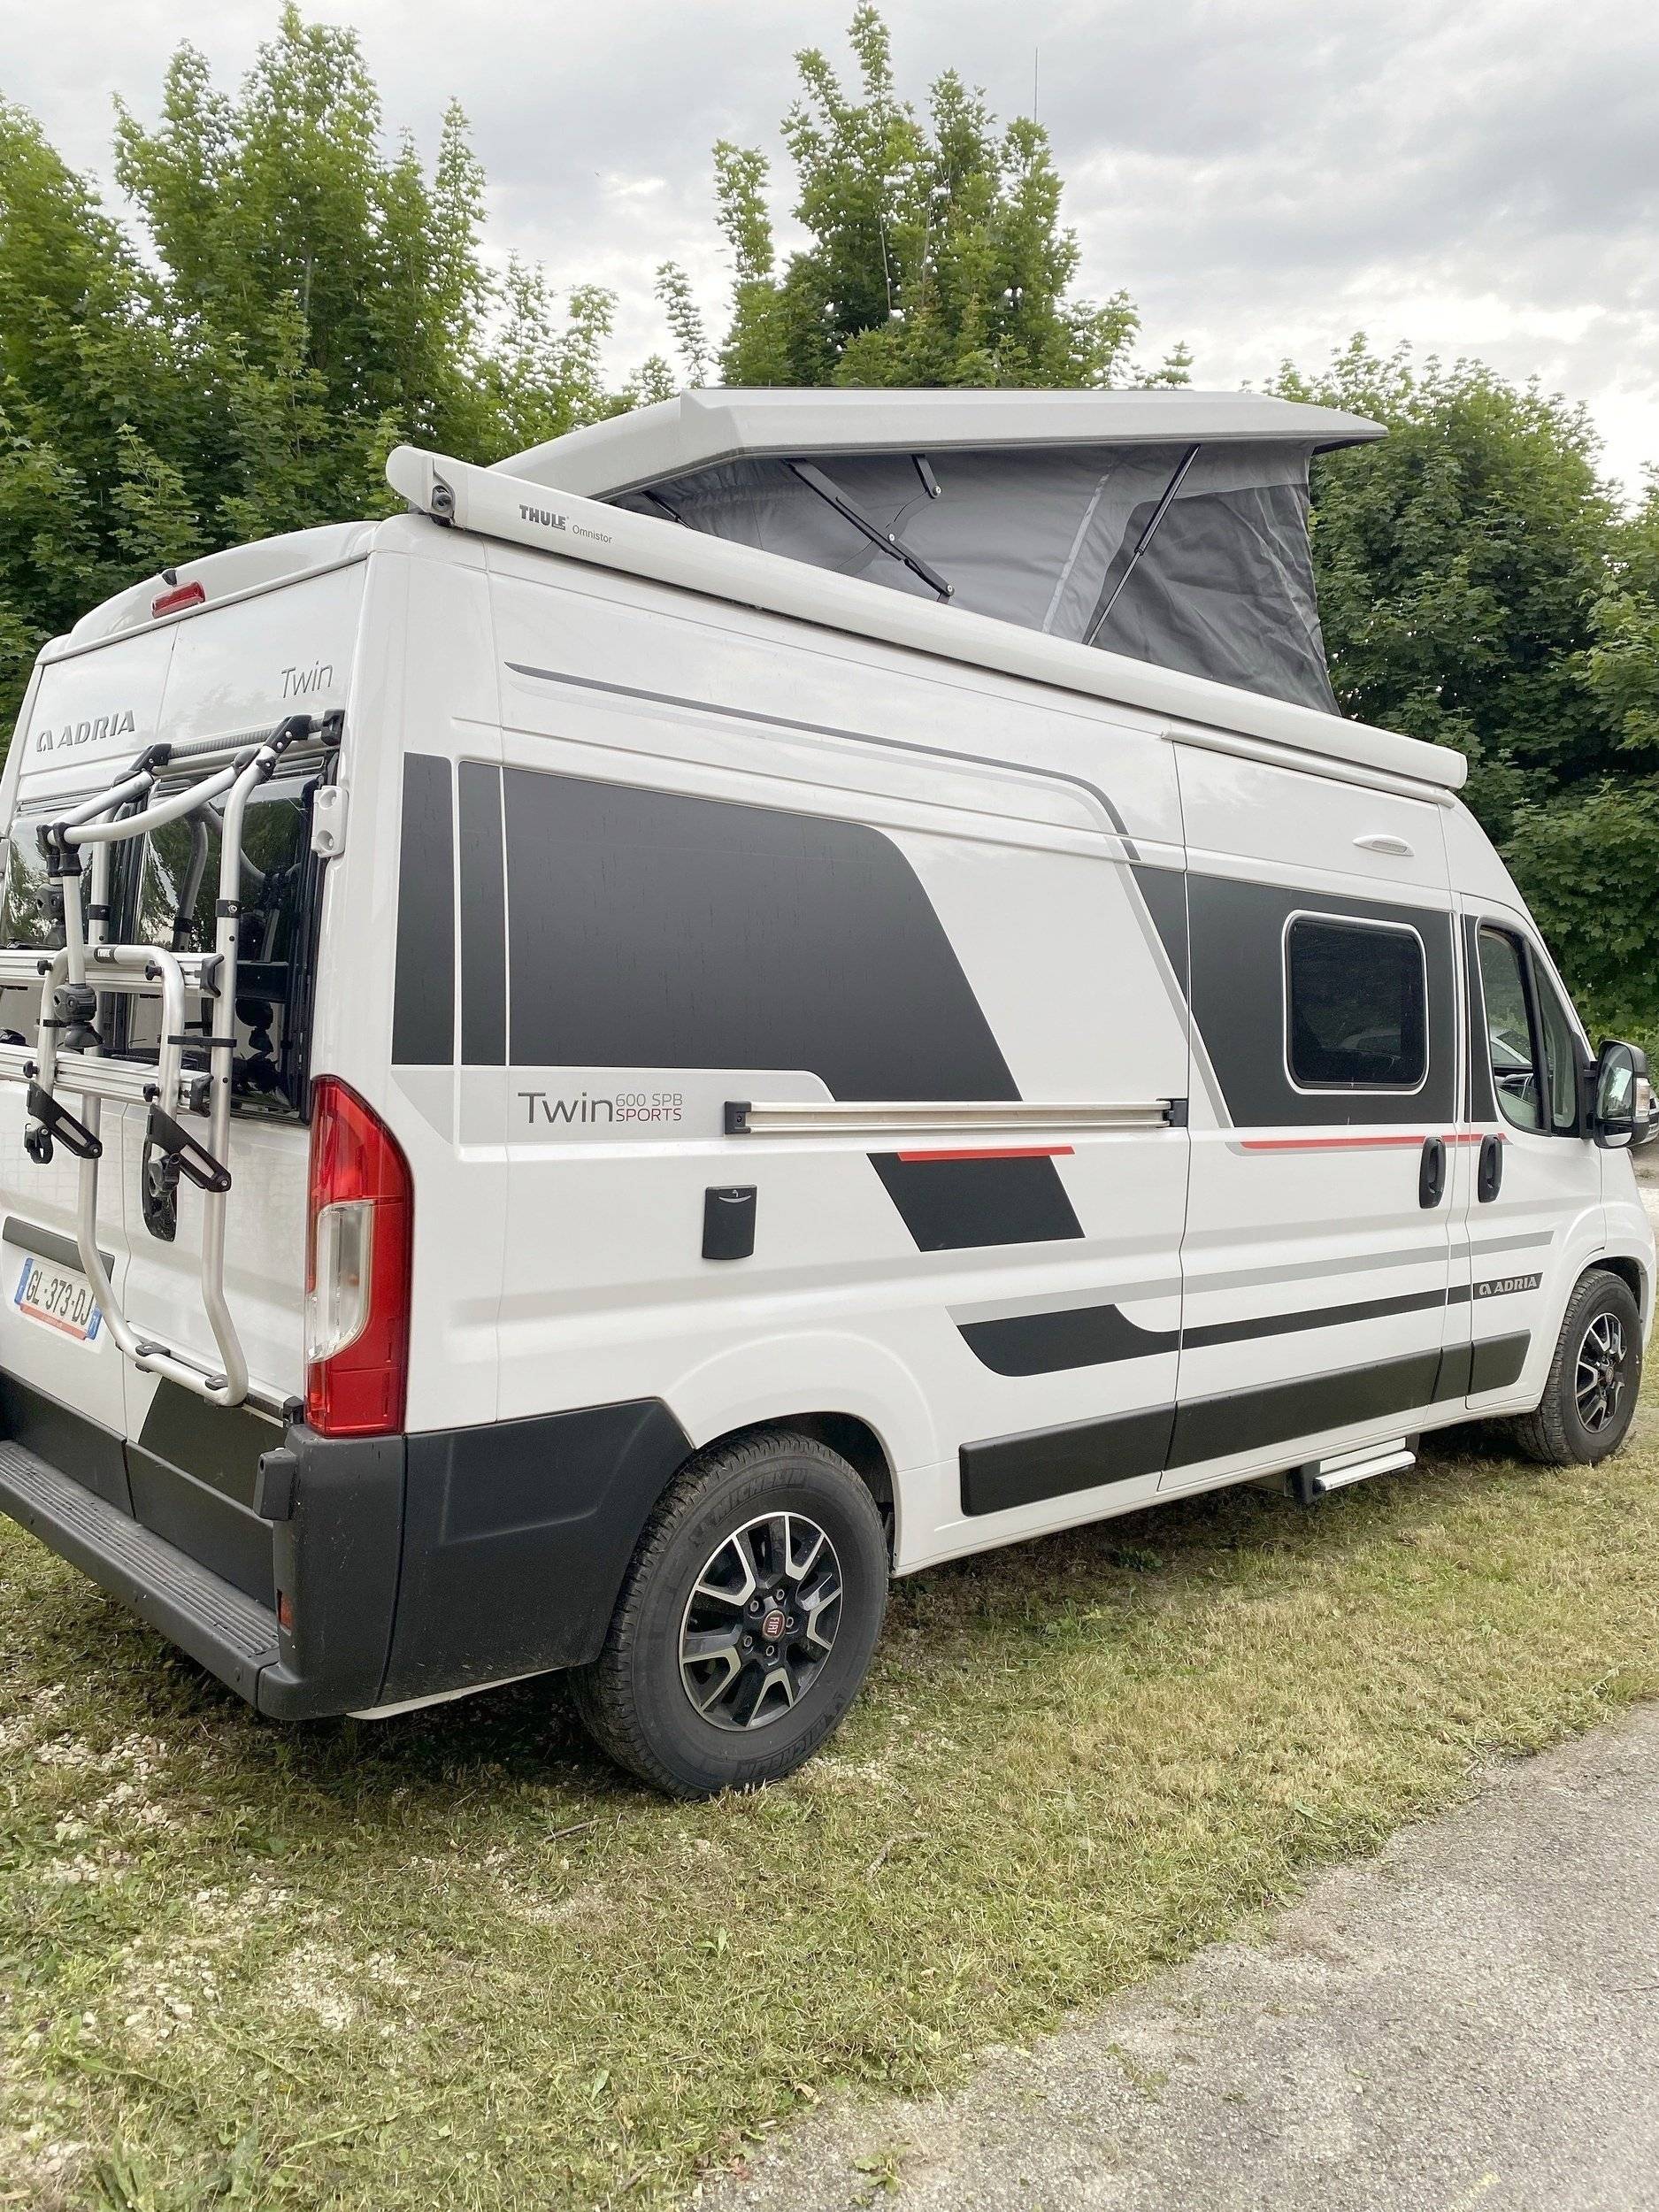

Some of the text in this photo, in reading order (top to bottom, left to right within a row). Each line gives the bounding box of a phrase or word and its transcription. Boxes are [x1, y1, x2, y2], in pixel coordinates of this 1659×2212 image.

[518, 503, 613, 544] THULE Omnistor
[280, 659, 334, 699] Twin
[57, 710, 135, 749] ADRIA
[517, 1091, 684, 1124] Twin 600 SPB
[615, 1107, 683, 1123] SPORTS
[1494, 1276, 1538, 1294] ADRIA
